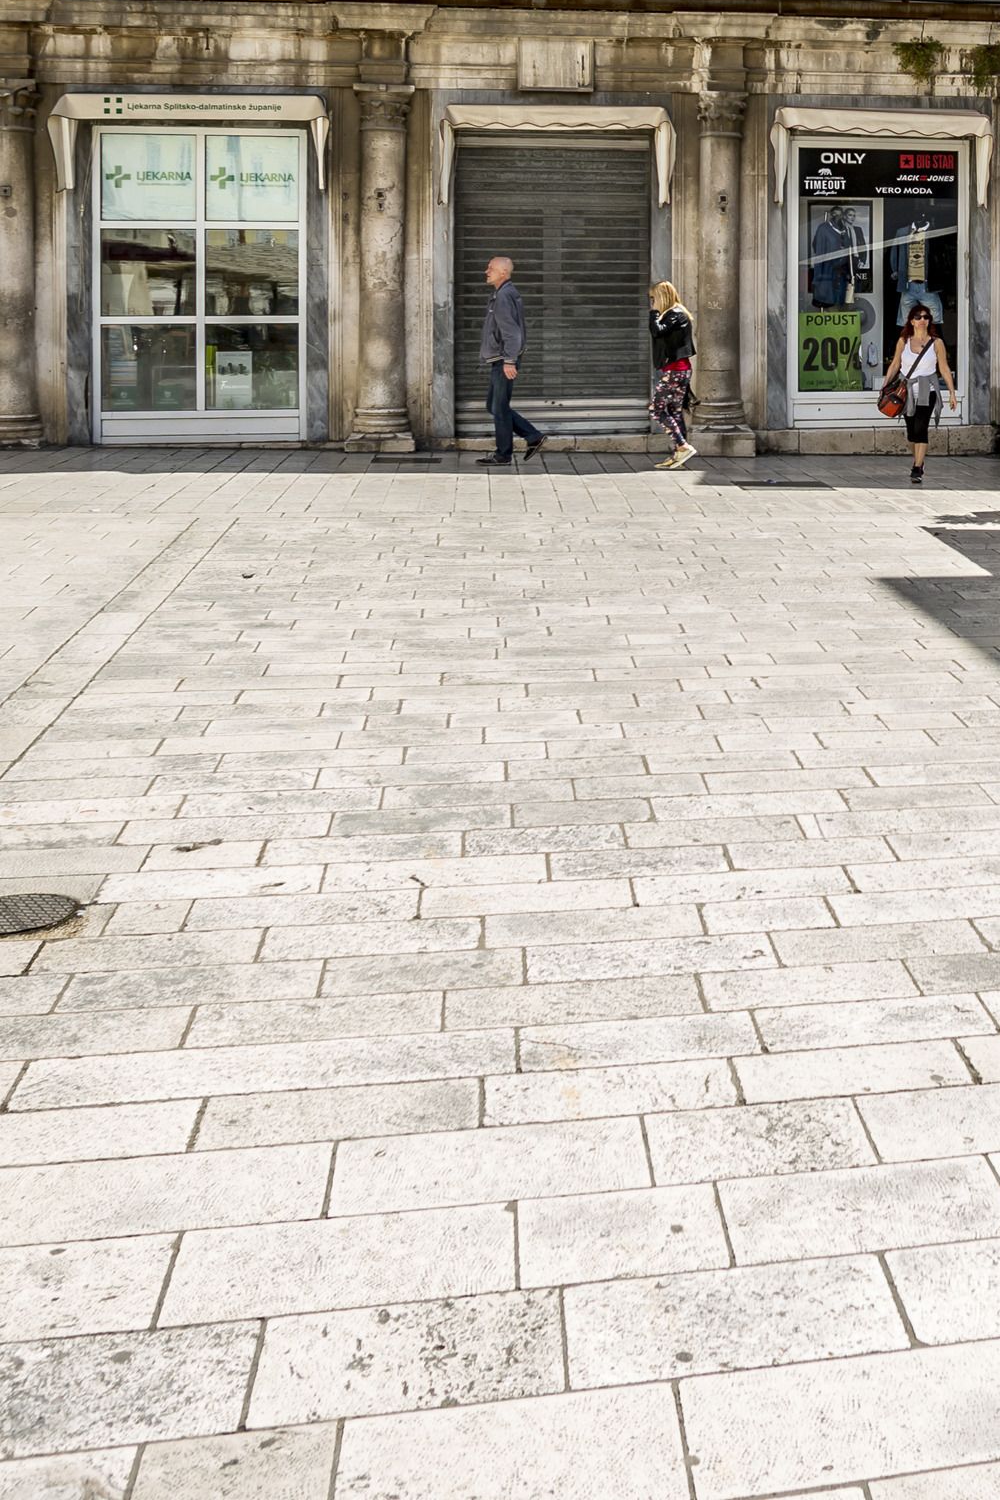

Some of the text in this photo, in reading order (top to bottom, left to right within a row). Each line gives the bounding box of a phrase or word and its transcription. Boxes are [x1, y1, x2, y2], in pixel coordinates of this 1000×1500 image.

[127, 102, 282, 113] Ljekarna Splitsko-dalmatinske županije
[820, 152, 866, 164] ONLY
[916, 154, 955, 169] BIG STAR
[136, 171, 192, 181] LJEKARNA
[240, 172, 295, 182] LJEKARNA
[803, 180, 847, 190] TIMEOUT
[875, 186, 933, 195] VERO MODA
[806, 314, 858, 326] POPUST
[802, 336, 862, 372] 20%
